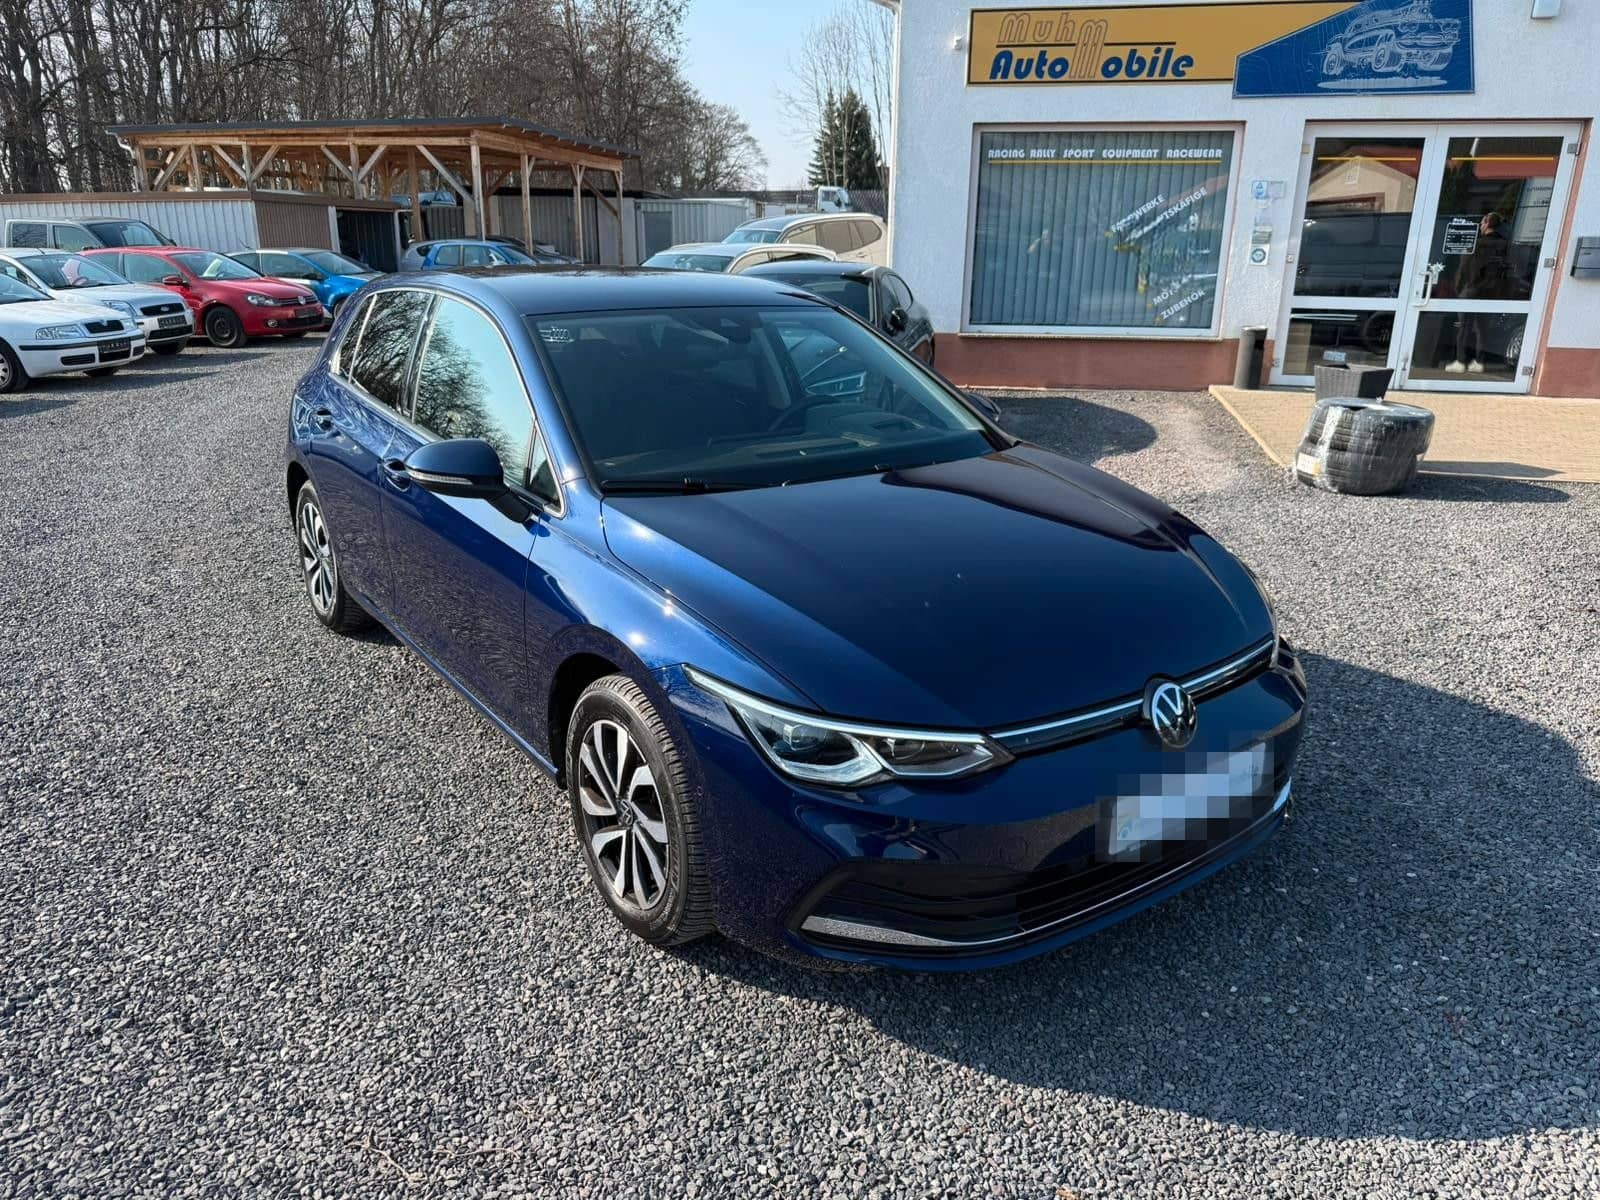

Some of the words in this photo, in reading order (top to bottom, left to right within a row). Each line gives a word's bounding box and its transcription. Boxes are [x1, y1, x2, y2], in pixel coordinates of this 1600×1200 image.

[988, 149, 1025, 158] RACING
[1030, 149, 1056, 158] RALLY
[1063, 149, 1095, 158] SPORT
[1102, 149, 1159, 158] EQUIPMENT
[1166, 149, 1222, 158] RACEWEAR
